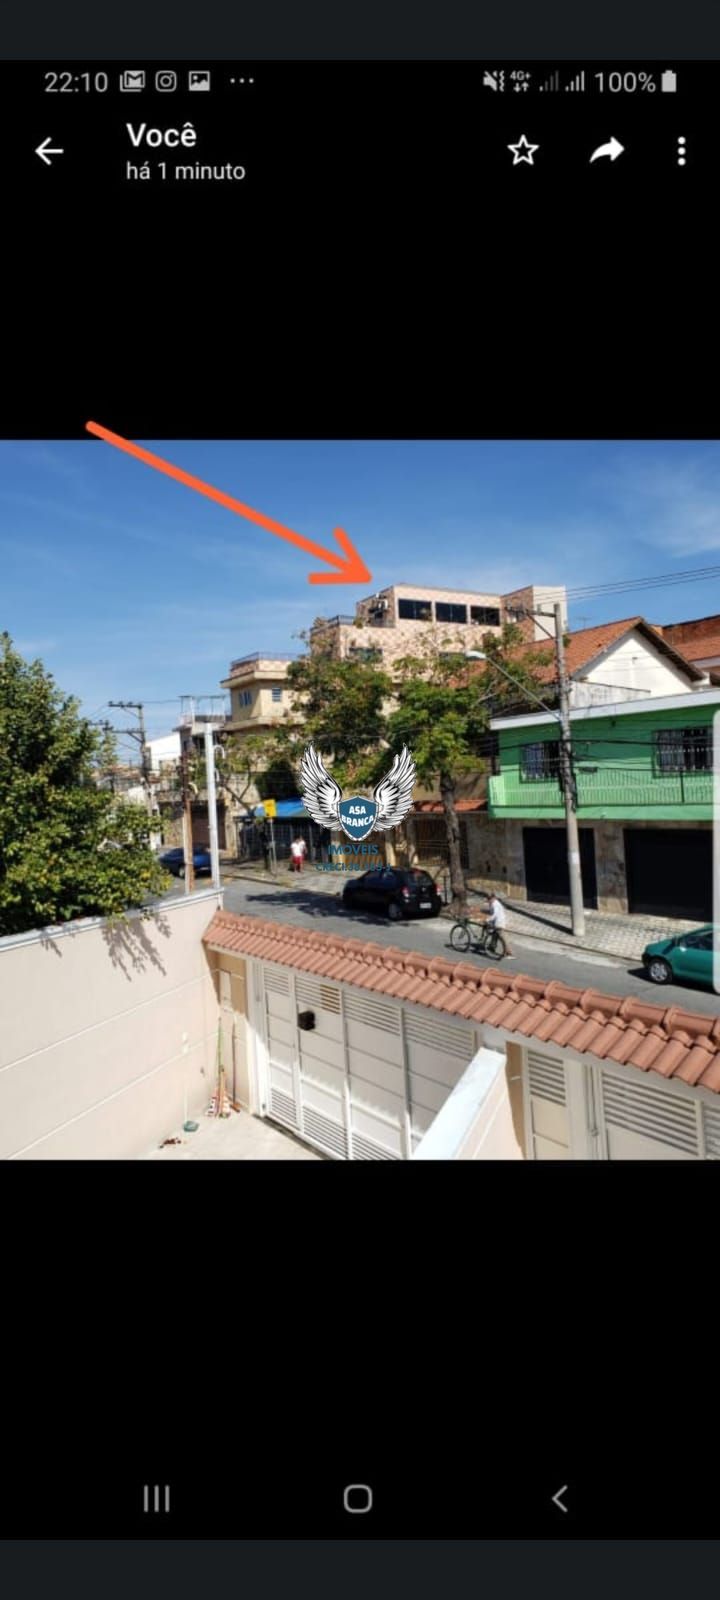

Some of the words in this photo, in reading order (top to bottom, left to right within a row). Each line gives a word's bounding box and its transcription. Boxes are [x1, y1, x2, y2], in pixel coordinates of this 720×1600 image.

[44, 71, 108, 93] 22:10
[594, 72, 656, 93] 100%
[125, 121, 197, 148] Você
[126, 160, 151, 180] há
[157, 161, 166, 180] 1
[175, 161, 246, 180] minuto
